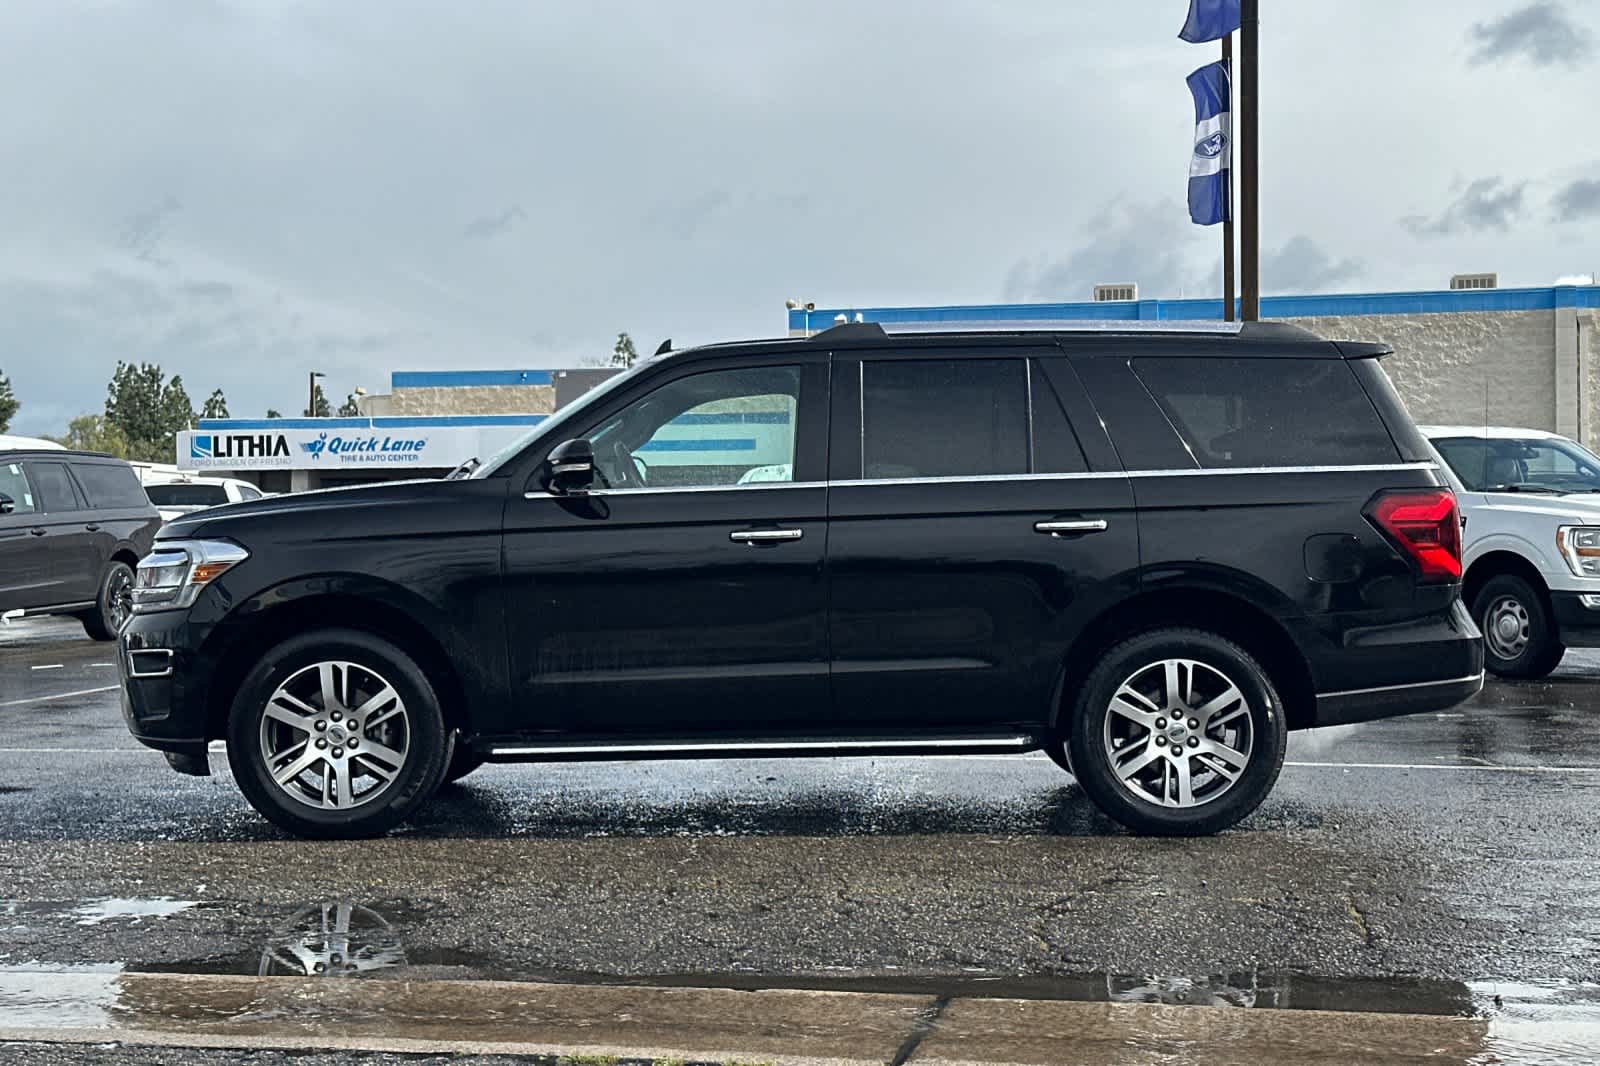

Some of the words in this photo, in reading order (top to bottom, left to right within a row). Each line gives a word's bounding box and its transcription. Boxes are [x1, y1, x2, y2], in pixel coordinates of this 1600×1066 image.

[213, 435, 290, 457] LITHIA
[328, 437, 378, 453] Quick
[380, 437, 425, 451] Lane
